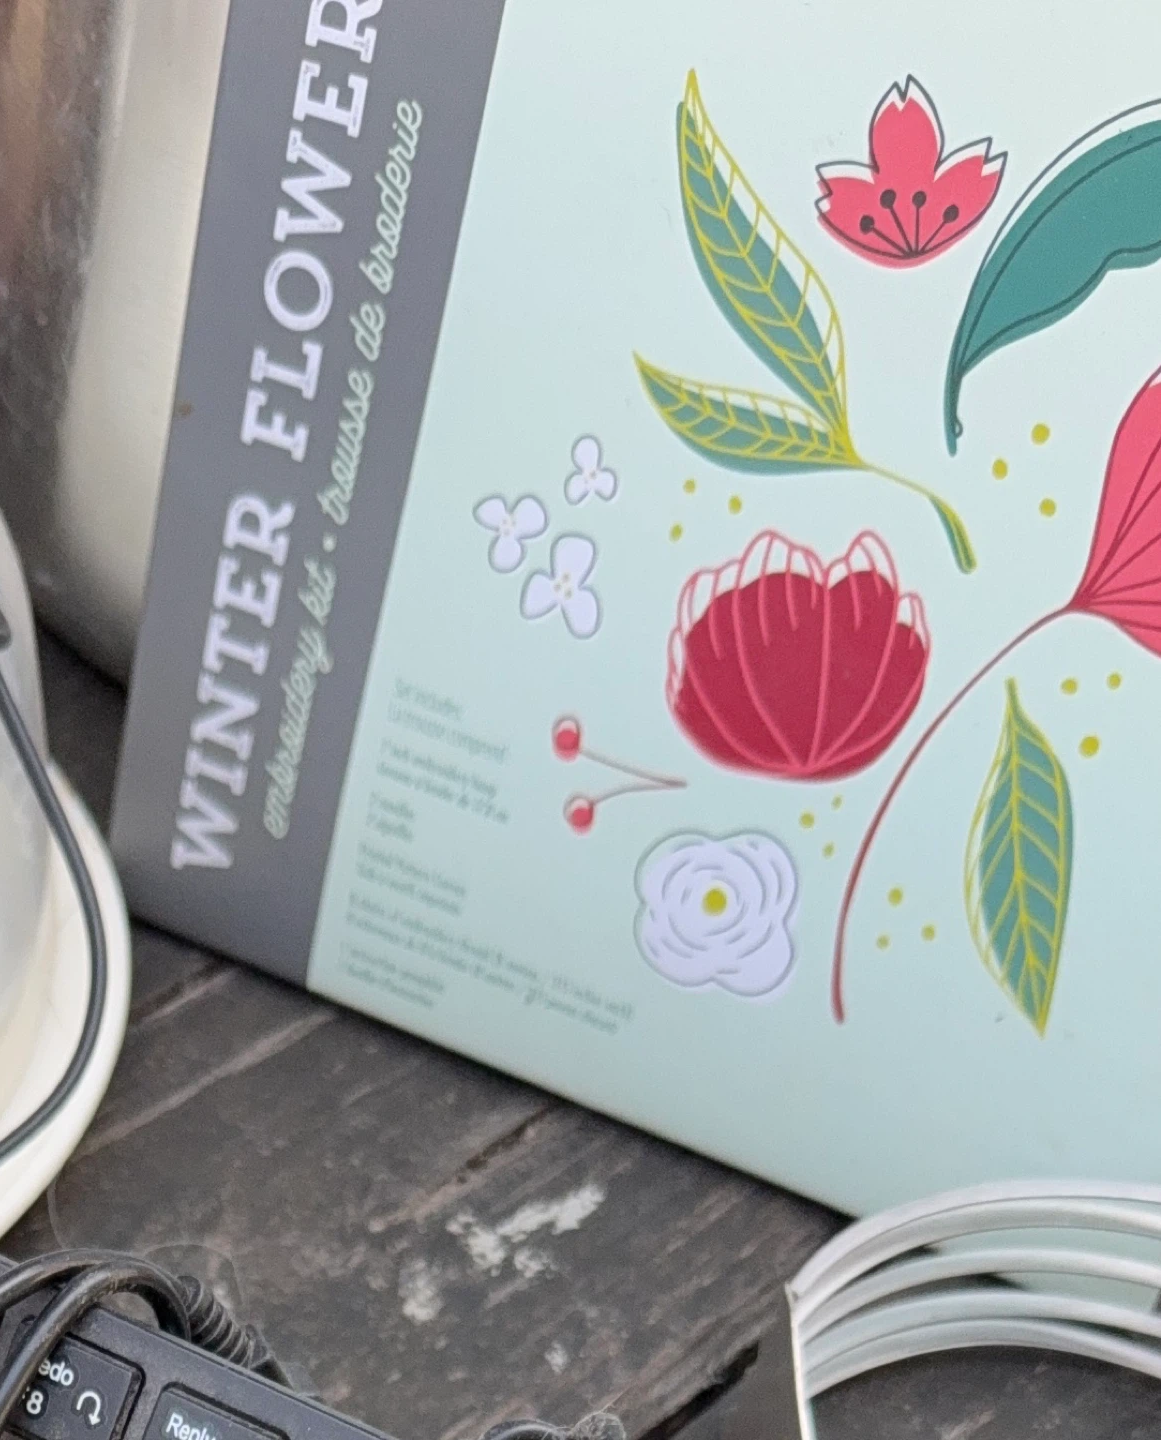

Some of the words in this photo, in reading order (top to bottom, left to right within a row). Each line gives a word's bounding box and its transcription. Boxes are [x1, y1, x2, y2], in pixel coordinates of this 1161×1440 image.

[359, 99, 423, 294] broderie
[350, 301, 387, 362] de
[316, 369, 375, 526] trousse
[297, 553, 336, 627] kit
[170, 494, 296, 870] WINTER
[263, 625, 334, 840] embroidery
[39, 1358, 74, 1386] edo
